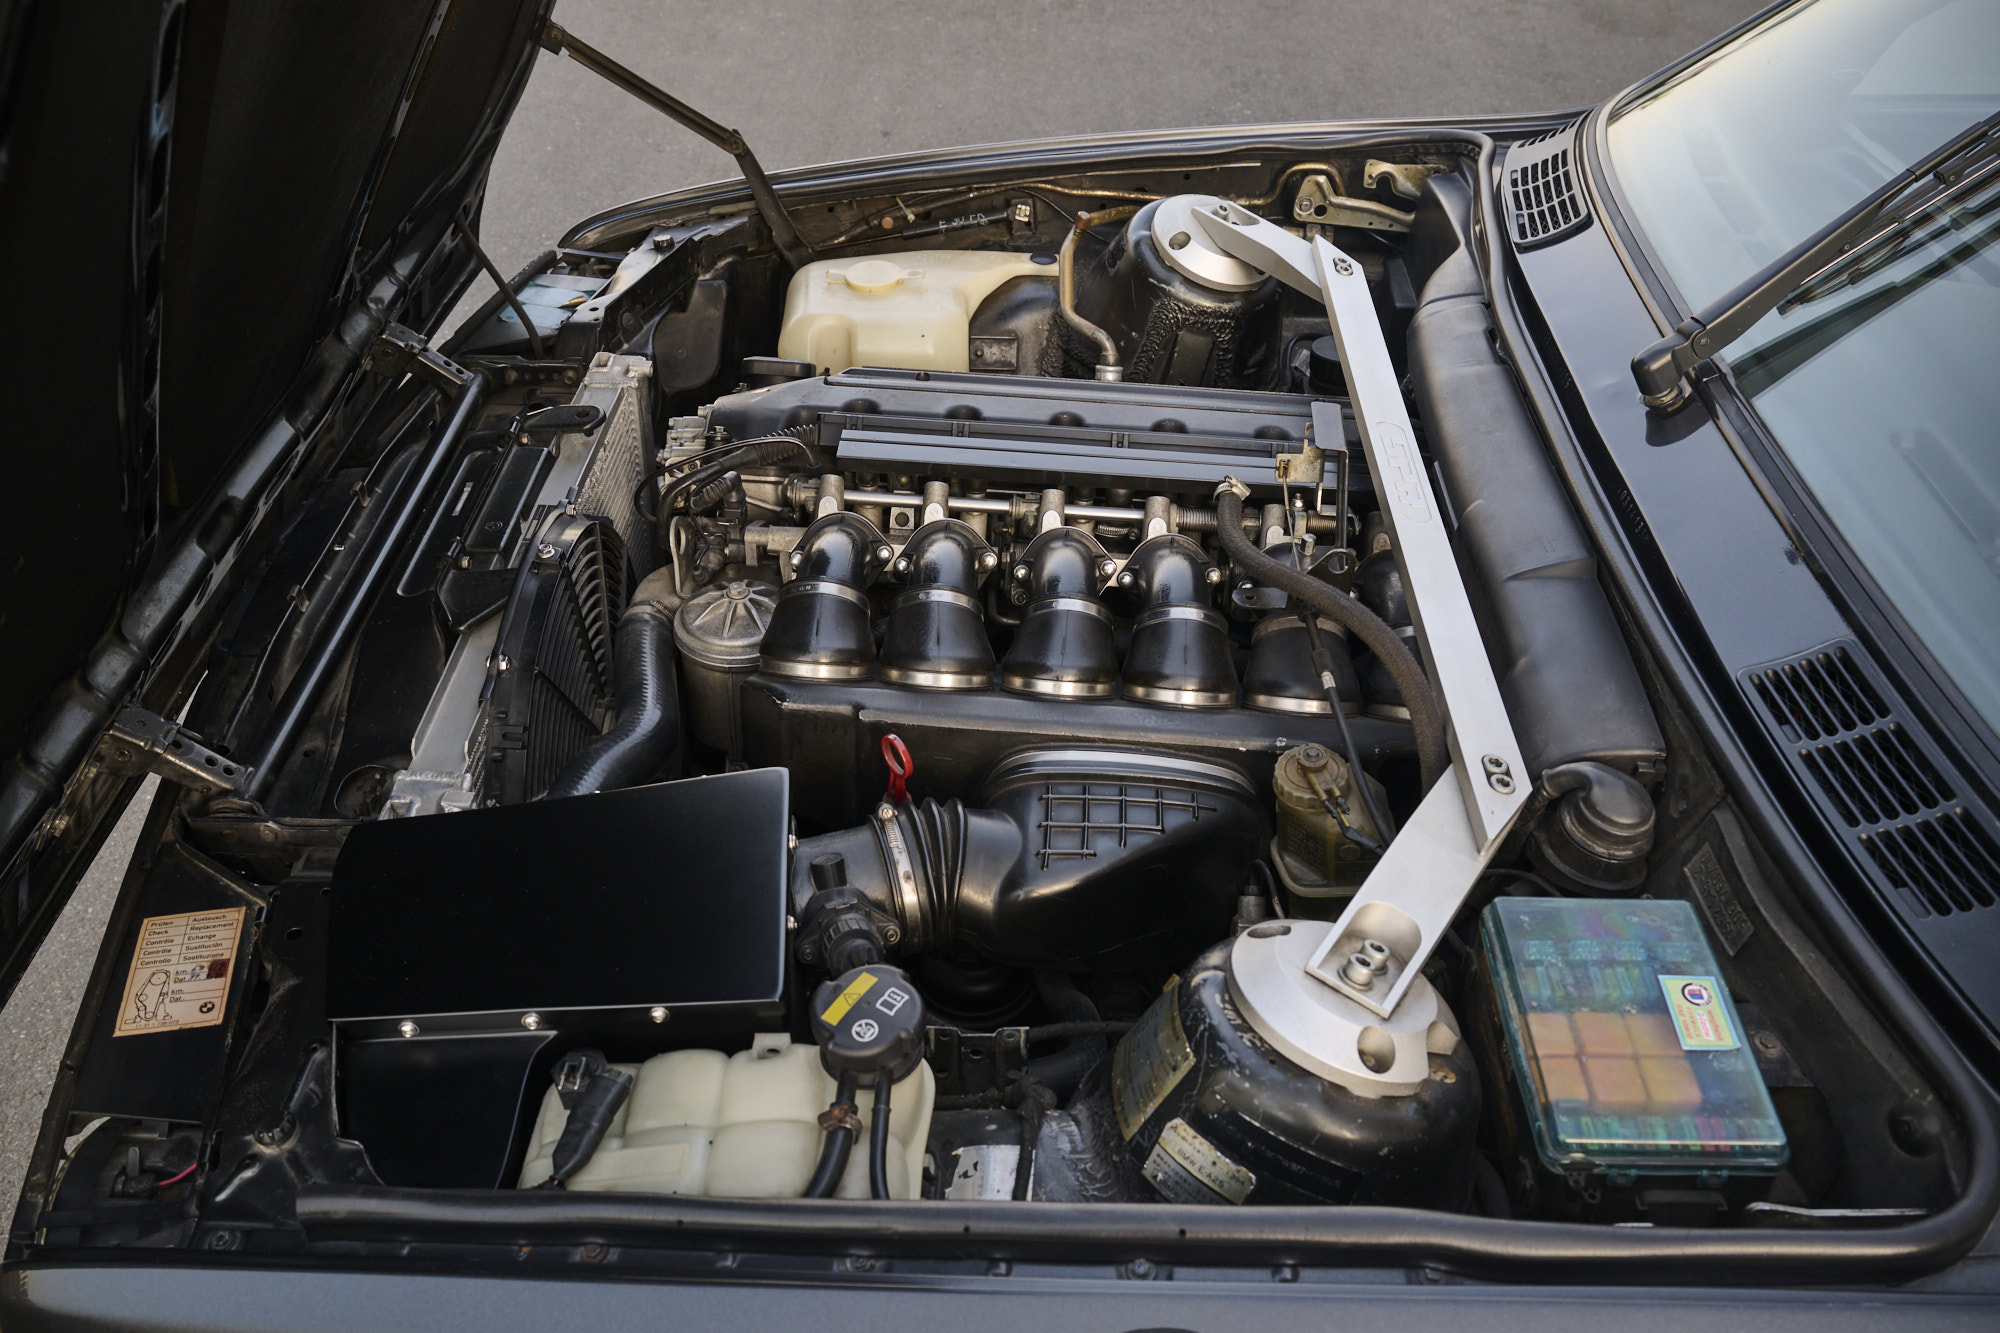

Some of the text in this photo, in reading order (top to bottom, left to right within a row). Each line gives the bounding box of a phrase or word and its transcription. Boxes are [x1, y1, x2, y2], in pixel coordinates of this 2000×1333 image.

[192, 914, 227, 922] Austausch
[190, 921, 234, 931] Replacement
[183, 952, 225, 961] Sostituzione
[140, 958, 172, 966] Controllo
[1177, 1148, 1197, 1167] BMW
